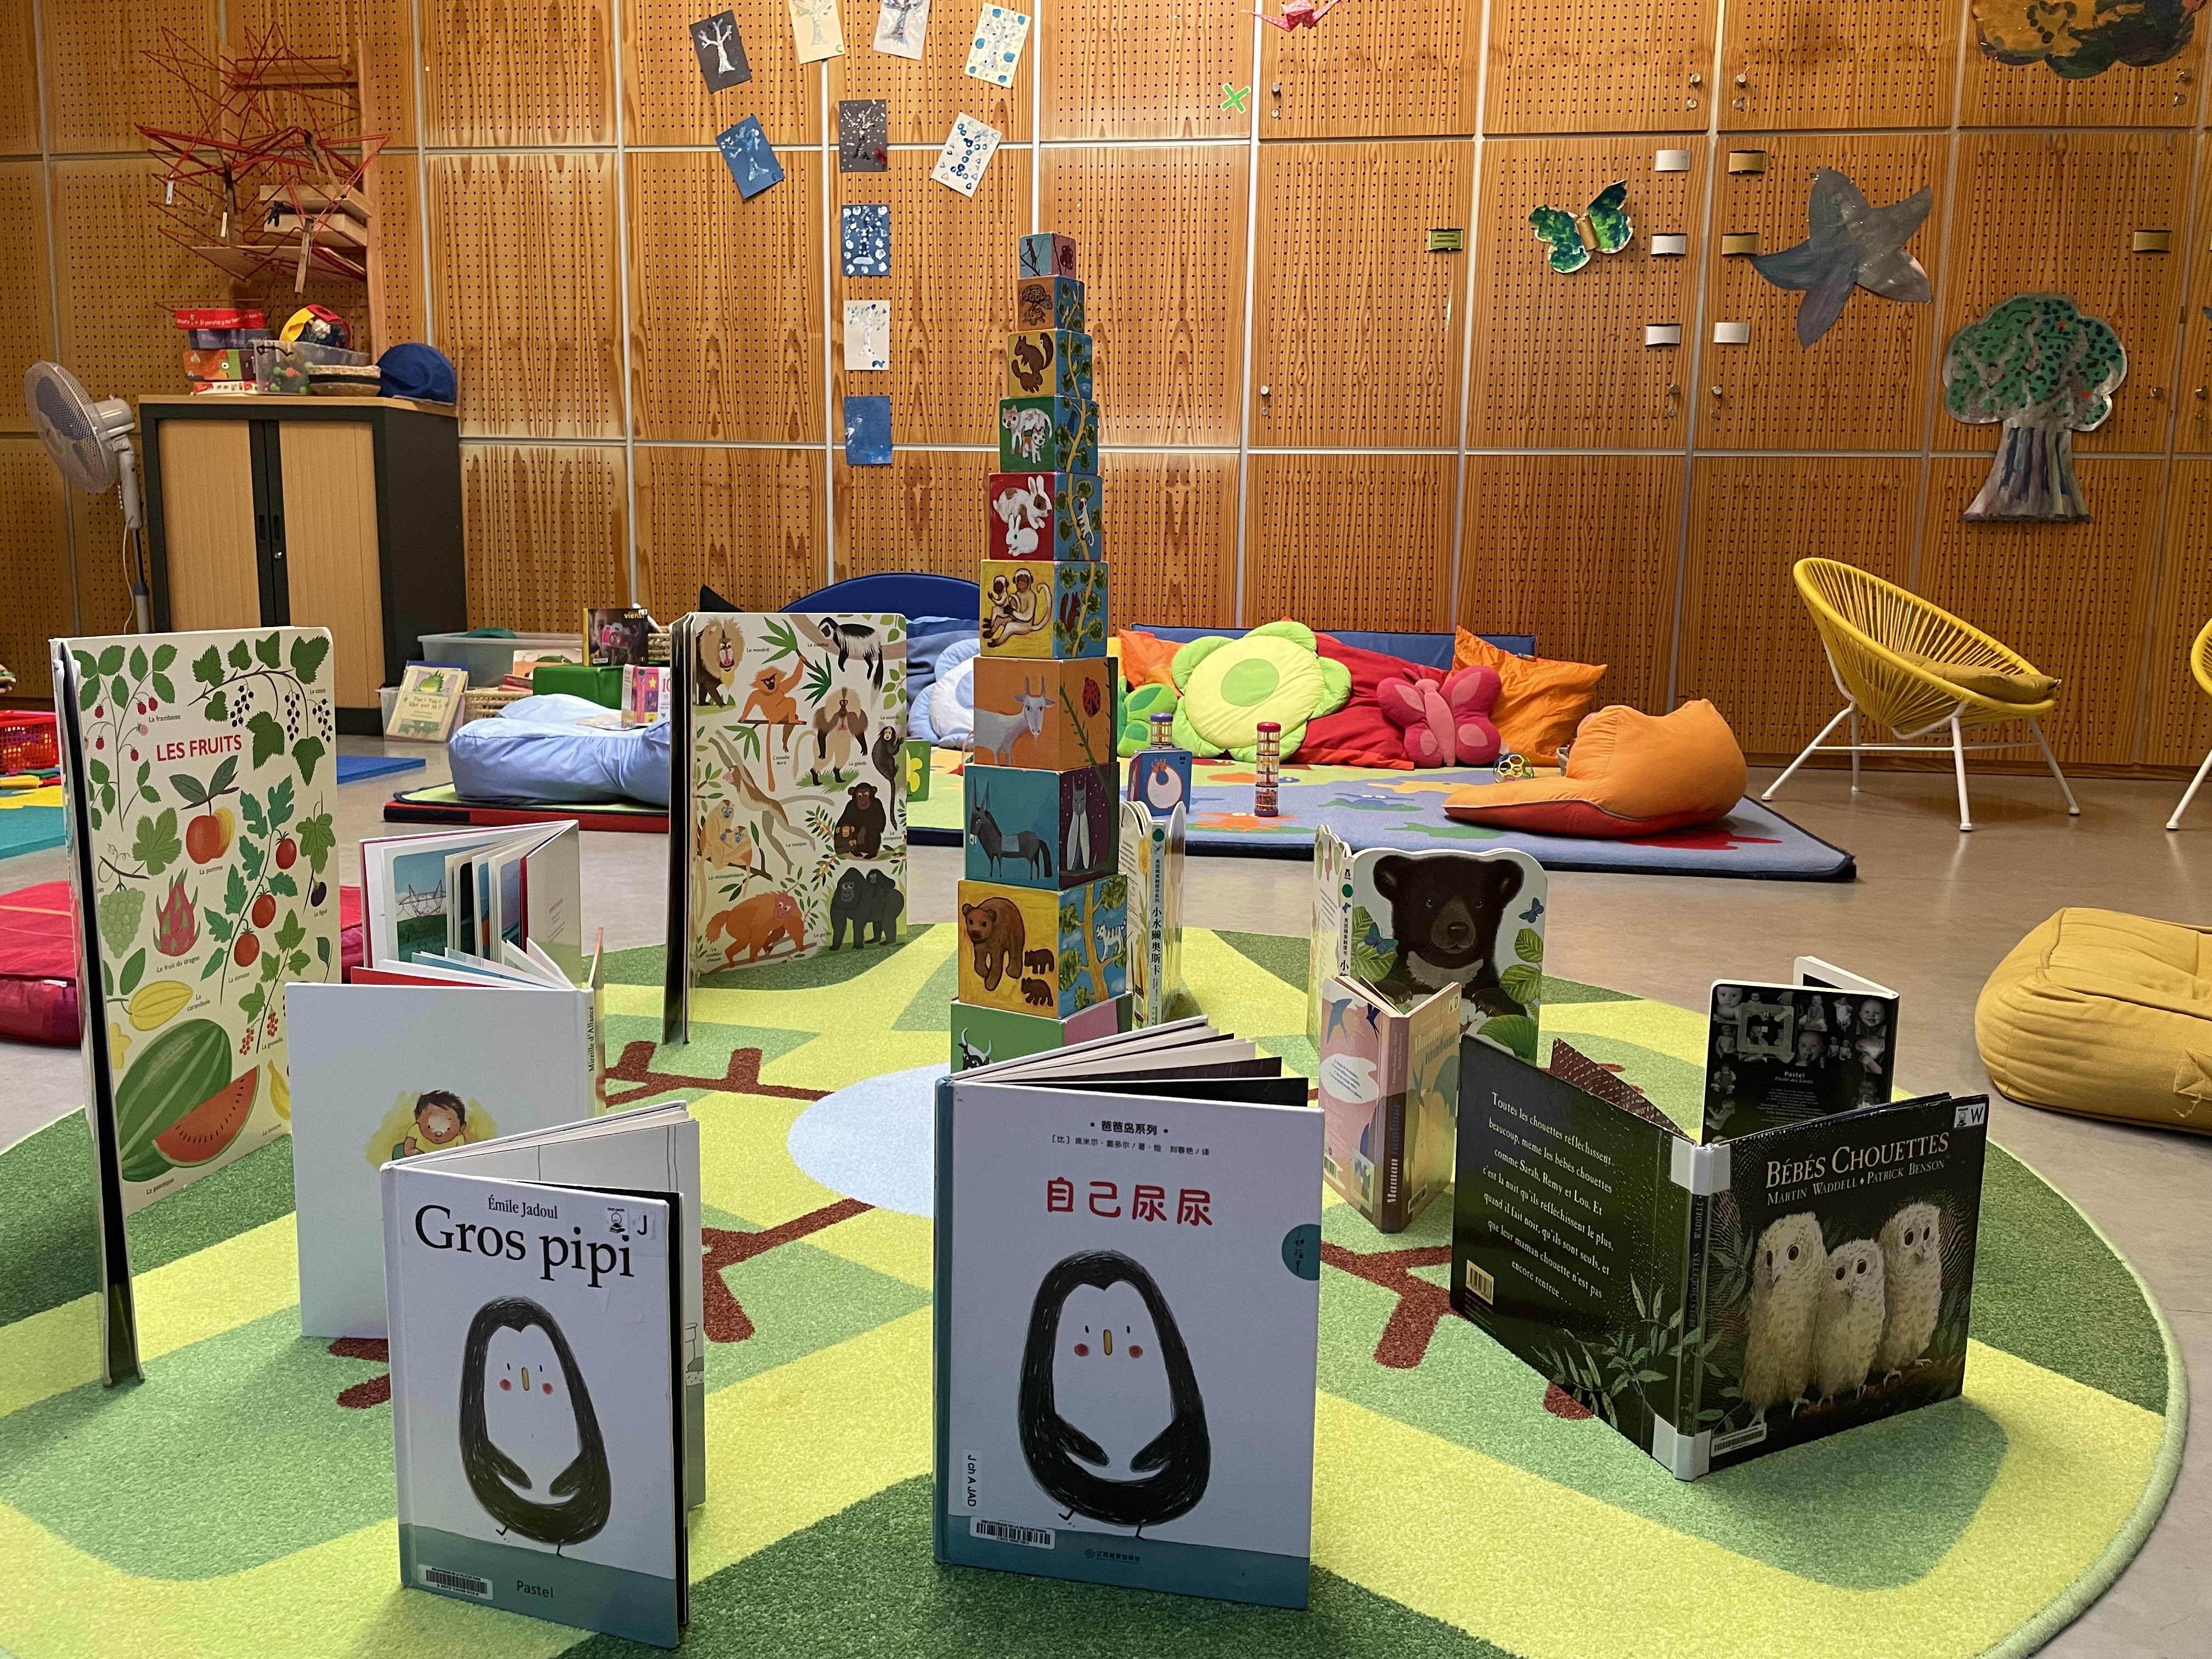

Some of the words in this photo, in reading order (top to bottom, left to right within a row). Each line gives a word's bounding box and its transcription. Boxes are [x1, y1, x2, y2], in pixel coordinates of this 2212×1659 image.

[156, 742, 185, 761] LES
[189, 734, 242, 757] FRUITS
[1101, 1120, 1158, 1136] 爸爸岛系列
[1492, 1091, 1517, 1116] Toutes
[1519, 1107, 1528, 1122] les
[1530, 1115, 1563, 1140] chouettes
[1564, 1135, 1612, 1165] réfléchissent
[1971, 1107, 1984, 1124] W
[1387, 1158, 1398, 1203] Maman
[1494, 1149, 1519, 1169] comme
[1565, 1188, 1572, 1198] et
[1593, 1199, 1602, 1216] Et
[1522, 1138, 1542, 1155] même
[1544, 1147, 1554, 1161] les
[1555, 1153, 1575, 1173] bébés
[1576, 1166, 1612, 1194] chouettes
[1765, 1154, 1826, 1188] BÉBÉS
[1832, 1132, 1950, 1173] CHOUETTES
[1767, 1187, 1808, 1206] MARTIN
[1813, 1177, 1858, 1195] WADDELL
[1867, 1167, 1905, 1184] PATRICK
[1909, 1159, 1945, 1176] BENSON
[487, 1194, 519, 1214] Émile
[521, 1201, 558, 1220] Jadoul
[1047, 1176, 1213, 1227] 自己尿尿
[1482, 1164, 1497, 1181] c'est
[1498, 1172, 1504, 1186] la
[1505, 1180, 1519, 1194] nuit
[1520, 1189, 1539, 1206] qu'ils
[1541, 1201, 1585, 1234] réfléchissent
[1587, 1225, 1594, 1239] le
[414, 1204, 527, 1261] Gros
[539, 1226, 635, 1289] pipi
[637, 1214, 648, 1236] J
[1483, 1193, 1503, 1210] quand
[1504, 1201, 1510, 1214] il
[1511, 1206, 1523, 1222] fait
[1542, 1228, 1561, 1246] qu'ils
[1562, 1240, 1578, 1256] sont
[1602, 1265, 1610, 1276] et
[1487, 1220, 1499, 1232] que
[1501, 1224, 1514, 1241] leur
[1515, 1237, 1539, 1258] maman
[1540, 1251, 1571, 1278] chouette
[1572, 1272, 1589, 1290] n'est
[1590, 1285, 1602, 1299] pas
[1511, 1261, 1534, 1280] encore
[1535, 1276, 1560, 1298] rentrée
[967, 1463, 977, 1475] ch
[968, 1476, 977, 1486] A
[967, 1486, 977, 1508] JAD
[516, 1579, 554, 1599] Pastel
